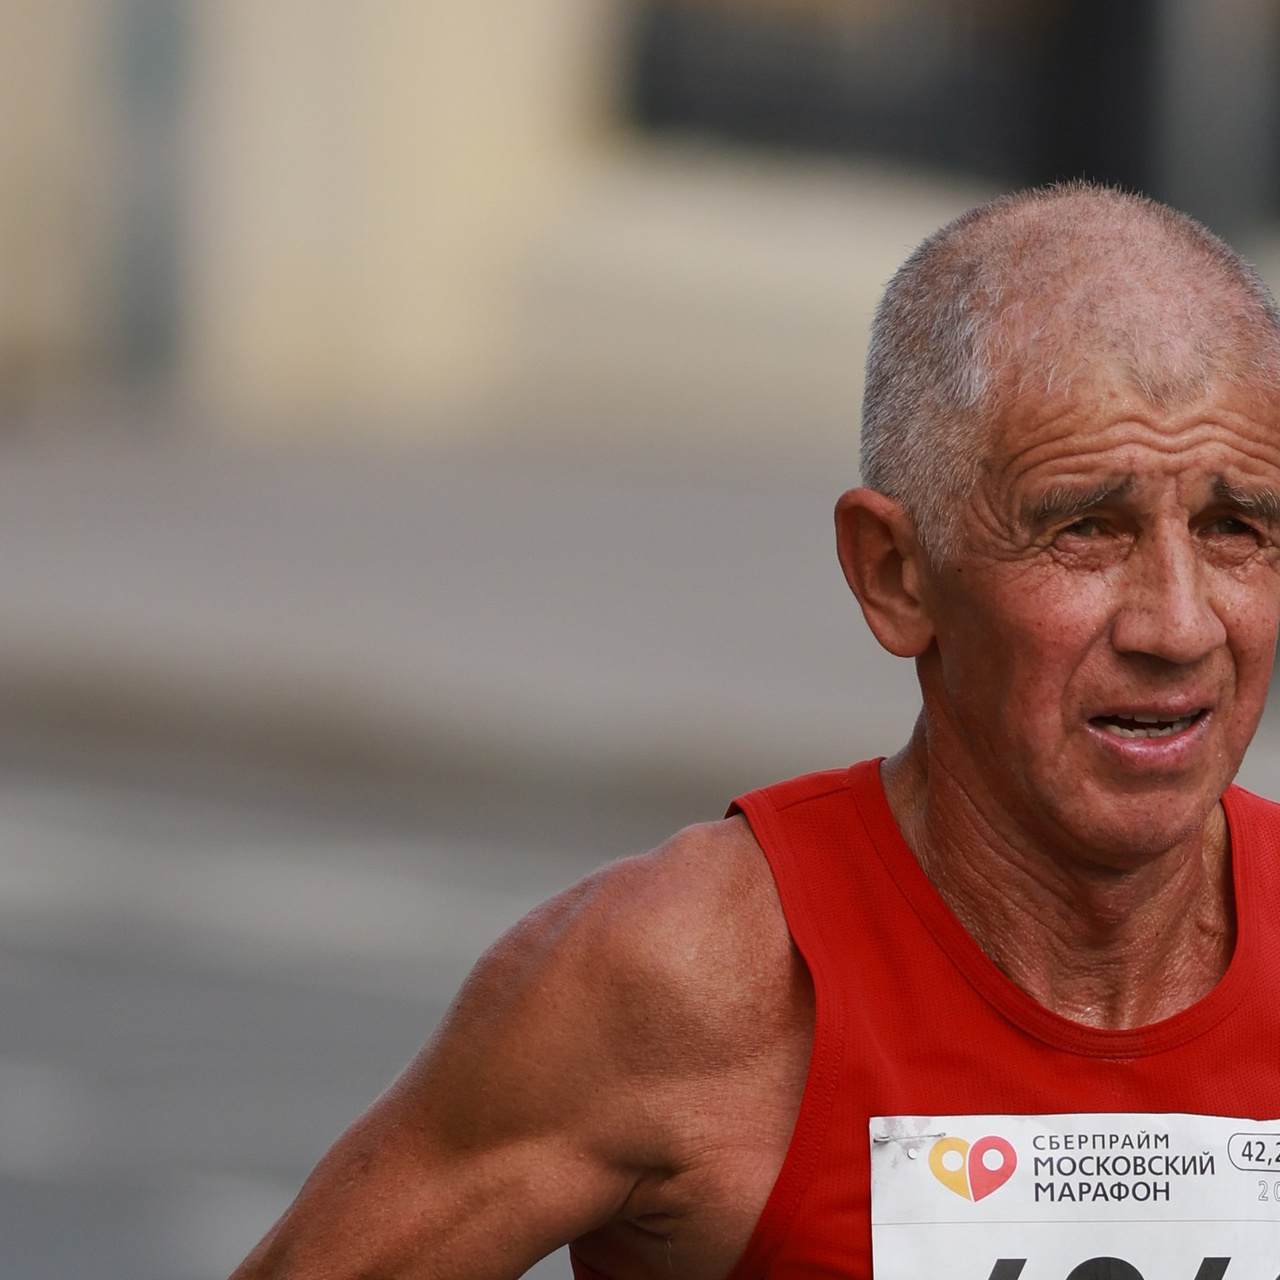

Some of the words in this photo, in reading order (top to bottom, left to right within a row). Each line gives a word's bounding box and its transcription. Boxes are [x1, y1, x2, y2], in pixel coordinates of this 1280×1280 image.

[1033, 1130, 1169, 1150] СБЕРПРАЙМ
[1034, 1151, 1215, 1176] МОСКОВСКИЙ
[1034, 1181, 1170, 1202] МАРАФОН
